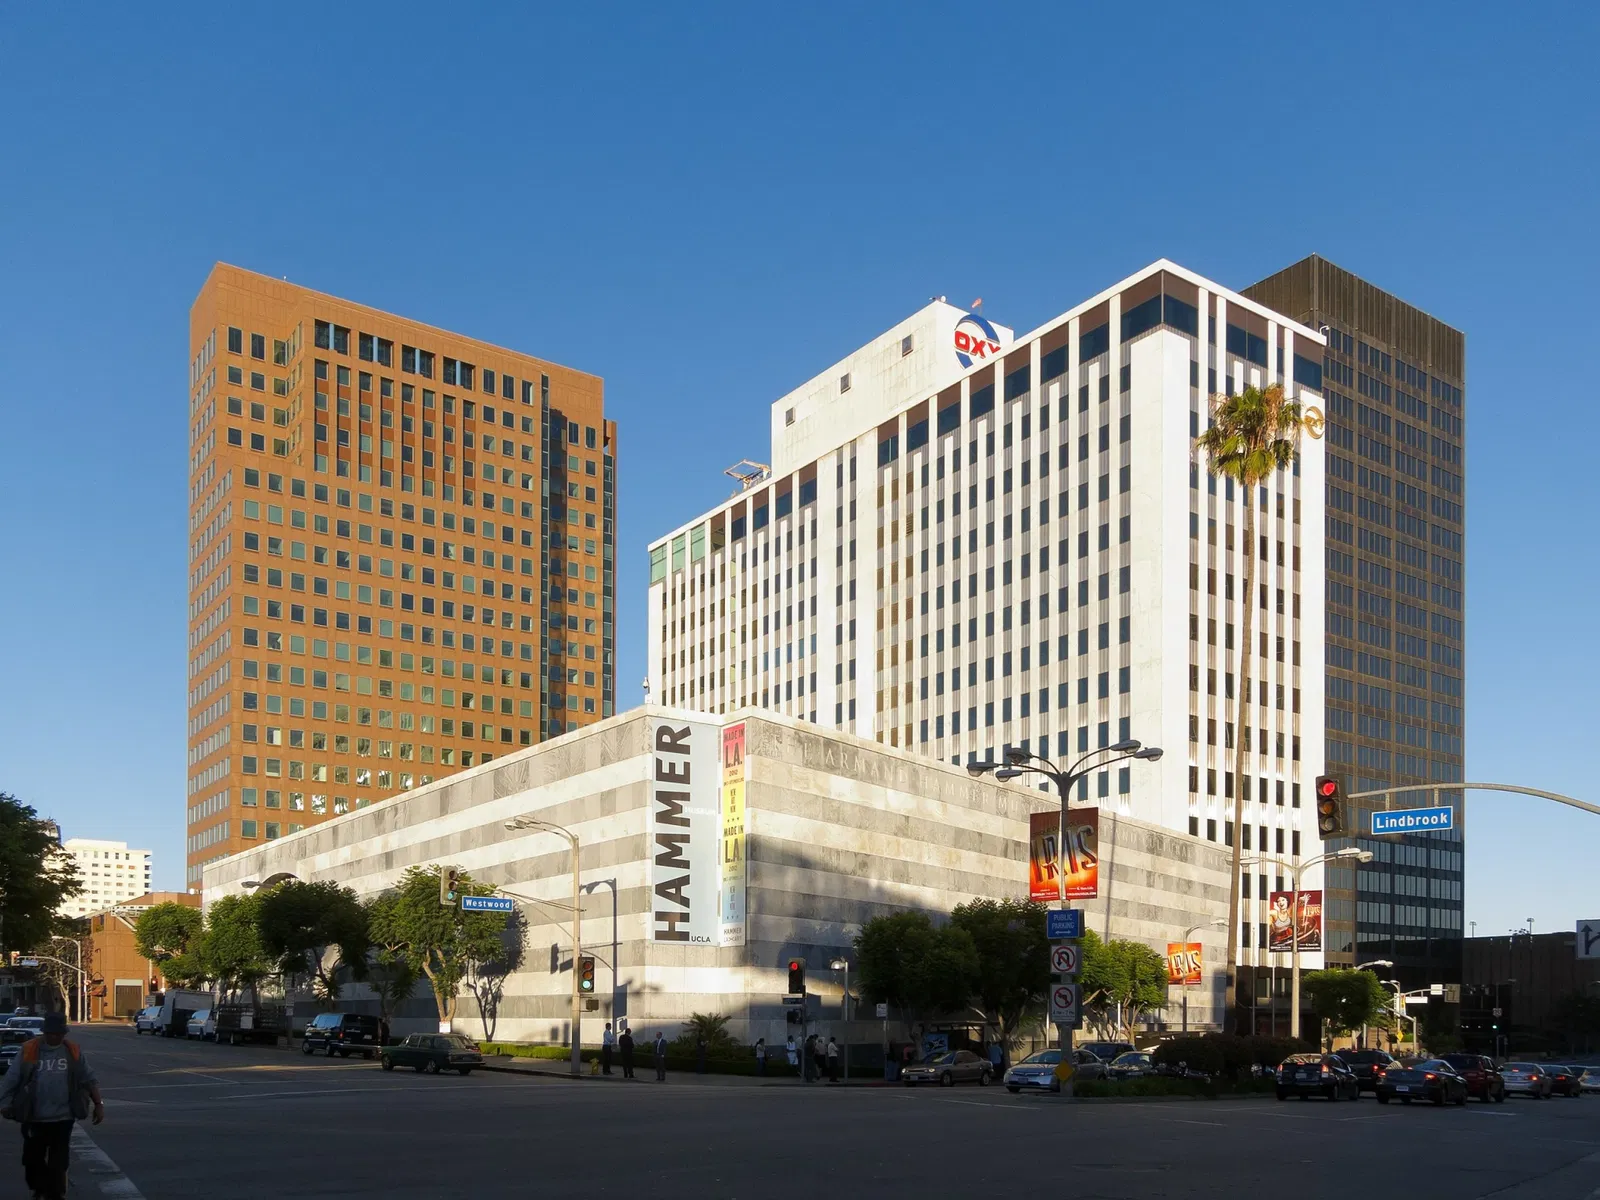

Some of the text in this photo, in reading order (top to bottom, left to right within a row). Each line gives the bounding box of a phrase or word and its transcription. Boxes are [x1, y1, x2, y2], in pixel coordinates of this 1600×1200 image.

[723, 727, 745, 743] MADE IN
[725, 742, 743, 769] L.A.
[825, 749, 909, 783] ARMAND
[723, 824, 744, 838] MADE IN
[1376, 812, 1448, 829] Lindbrook
[655, 725, 691, 942] HAMMER
[725, 838, 743, 864] L.A.
[1030, 824, 1097, 884] IRIS
[465, 899, 510, 909] Westwood
[1053, 913, 1073, 921] PUBLIC
[691, 935, 711, 943] UCLA
[1168, 949, 1201, 976] IRIS
